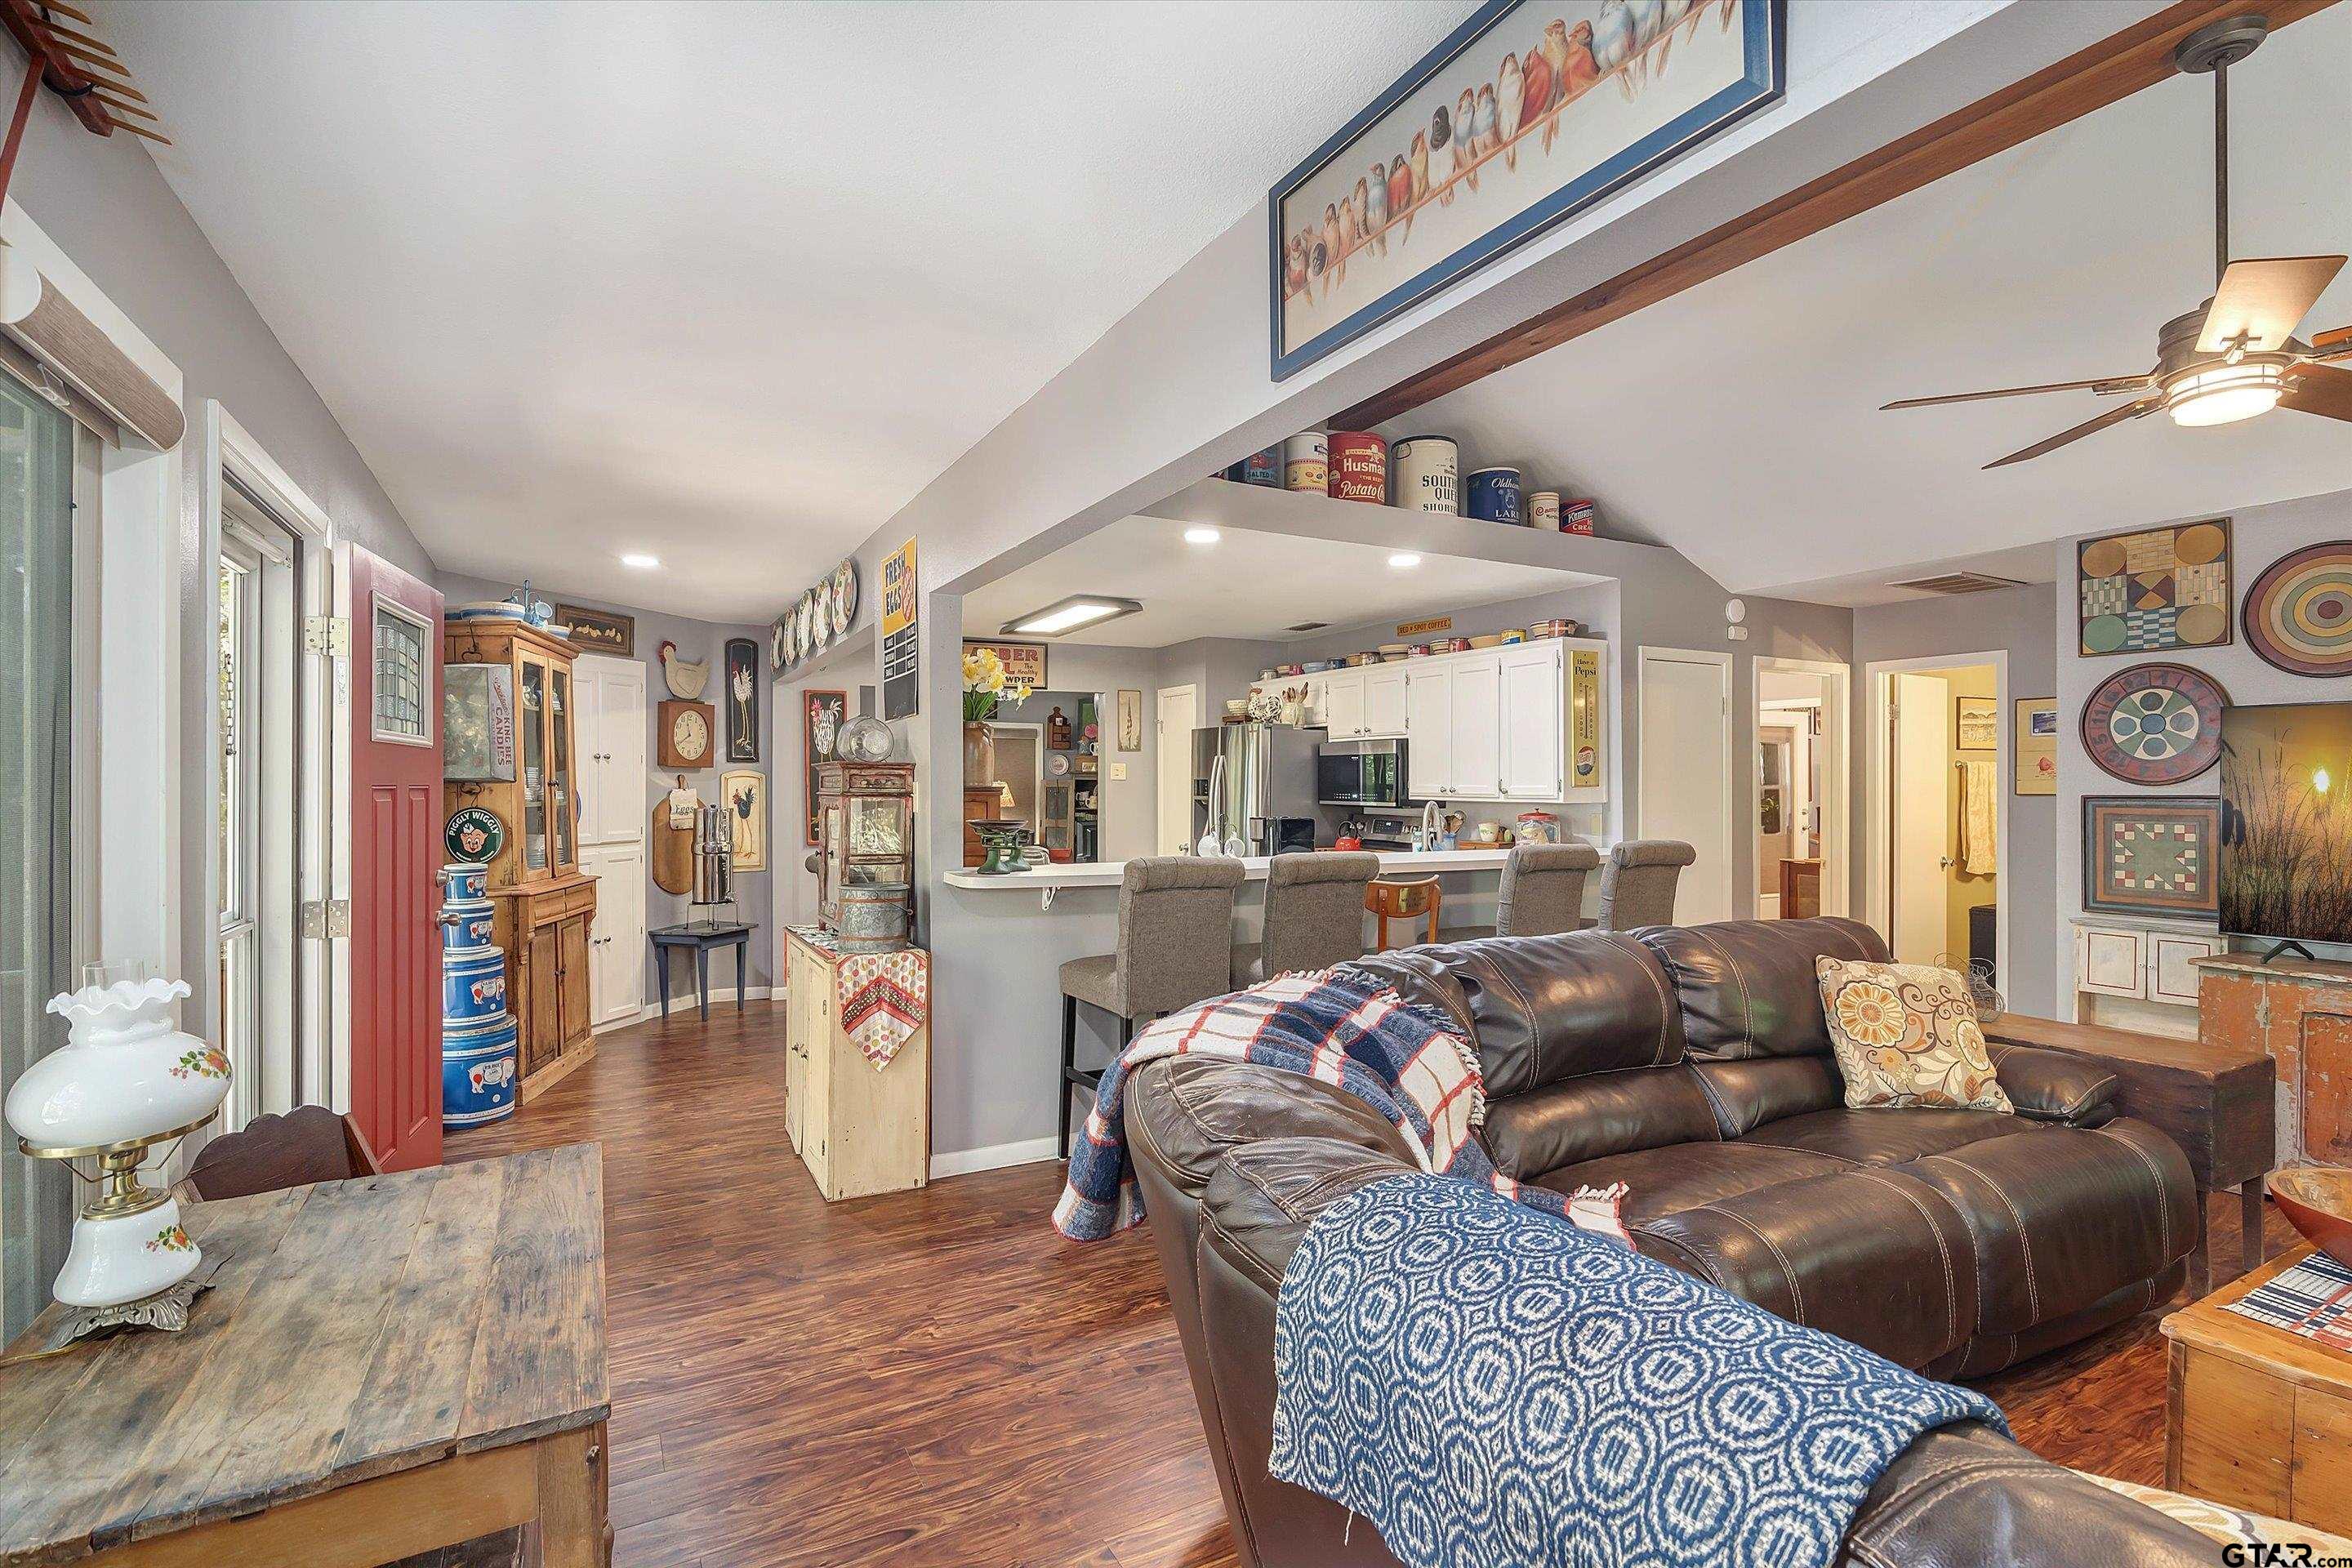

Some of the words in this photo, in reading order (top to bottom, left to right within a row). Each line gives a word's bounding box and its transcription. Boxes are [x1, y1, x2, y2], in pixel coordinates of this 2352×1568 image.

[1339, 480, 1377, 499] Potato
[884, 550, 906, 588] FRESH
[885, 584, 902, 617] EGGS
[1399, 626, 1409, 634] RED
[1414, 623, 1427, 631] SPOT
[1428, 619, 1447, 630] COFFEE
[1018, 669, 1037, 677] Healthy
[1575, 666, 1596, 678] Pepsi
[495, 706, 505, 766] CANDIES
[503, 718, 511, 743] KING
[675, 804, 694, 816] Eggs
[448, 812, 470, 836] PIGGLY
[472, 811, 499, 834] WIGGLY
